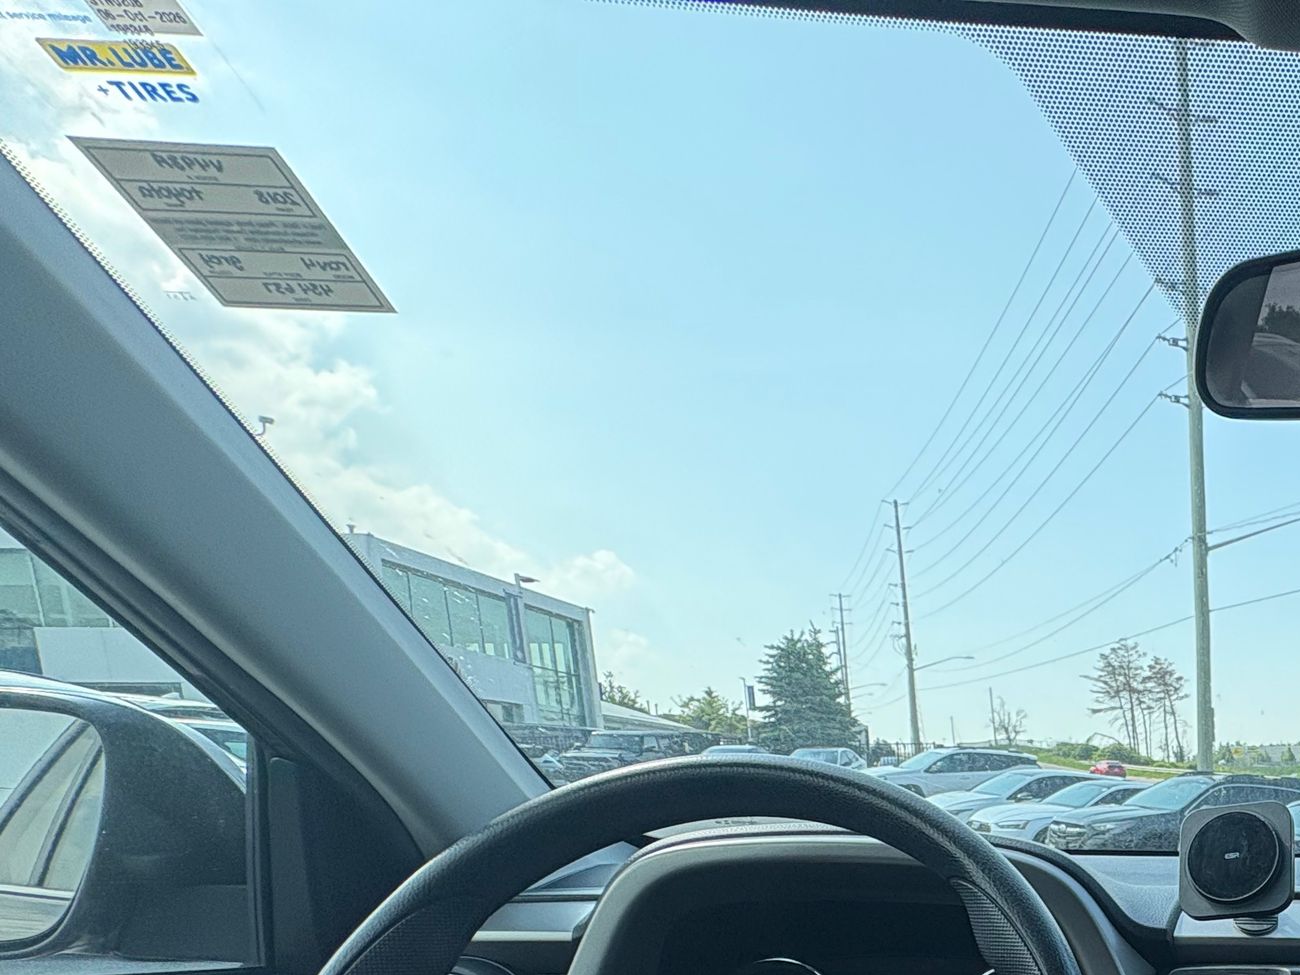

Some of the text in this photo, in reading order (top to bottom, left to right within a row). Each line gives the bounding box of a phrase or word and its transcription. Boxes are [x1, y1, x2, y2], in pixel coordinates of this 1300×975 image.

[48, 43, 184, 70] MR. LUBE
[106, 80, 200, 103] TIRES
